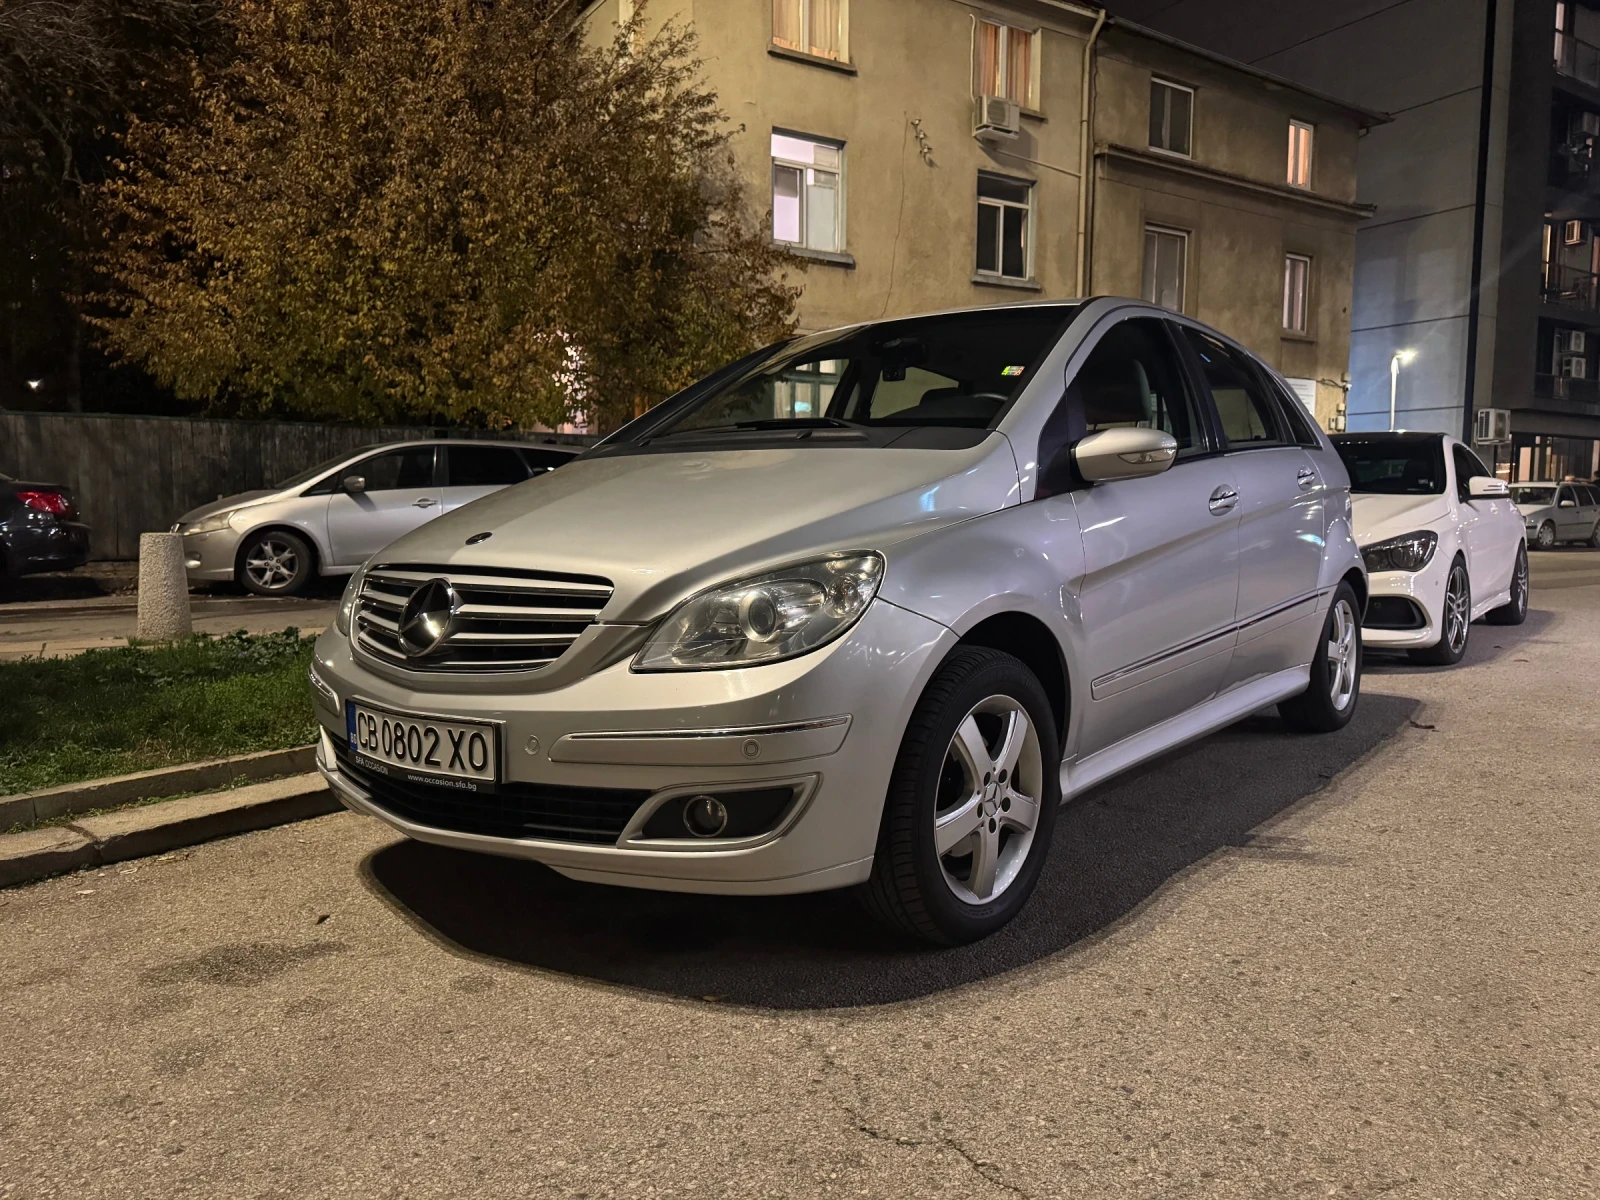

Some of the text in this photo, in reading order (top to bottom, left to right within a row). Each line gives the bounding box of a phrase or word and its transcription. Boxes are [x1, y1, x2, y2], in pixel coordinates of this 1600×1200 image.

[358, 711, 488, 772] CB 0802 XO
[355, 755, 389, 775] SFA OCCASION
[407, 774, 477, 792] www.occasion.sfa.bg
